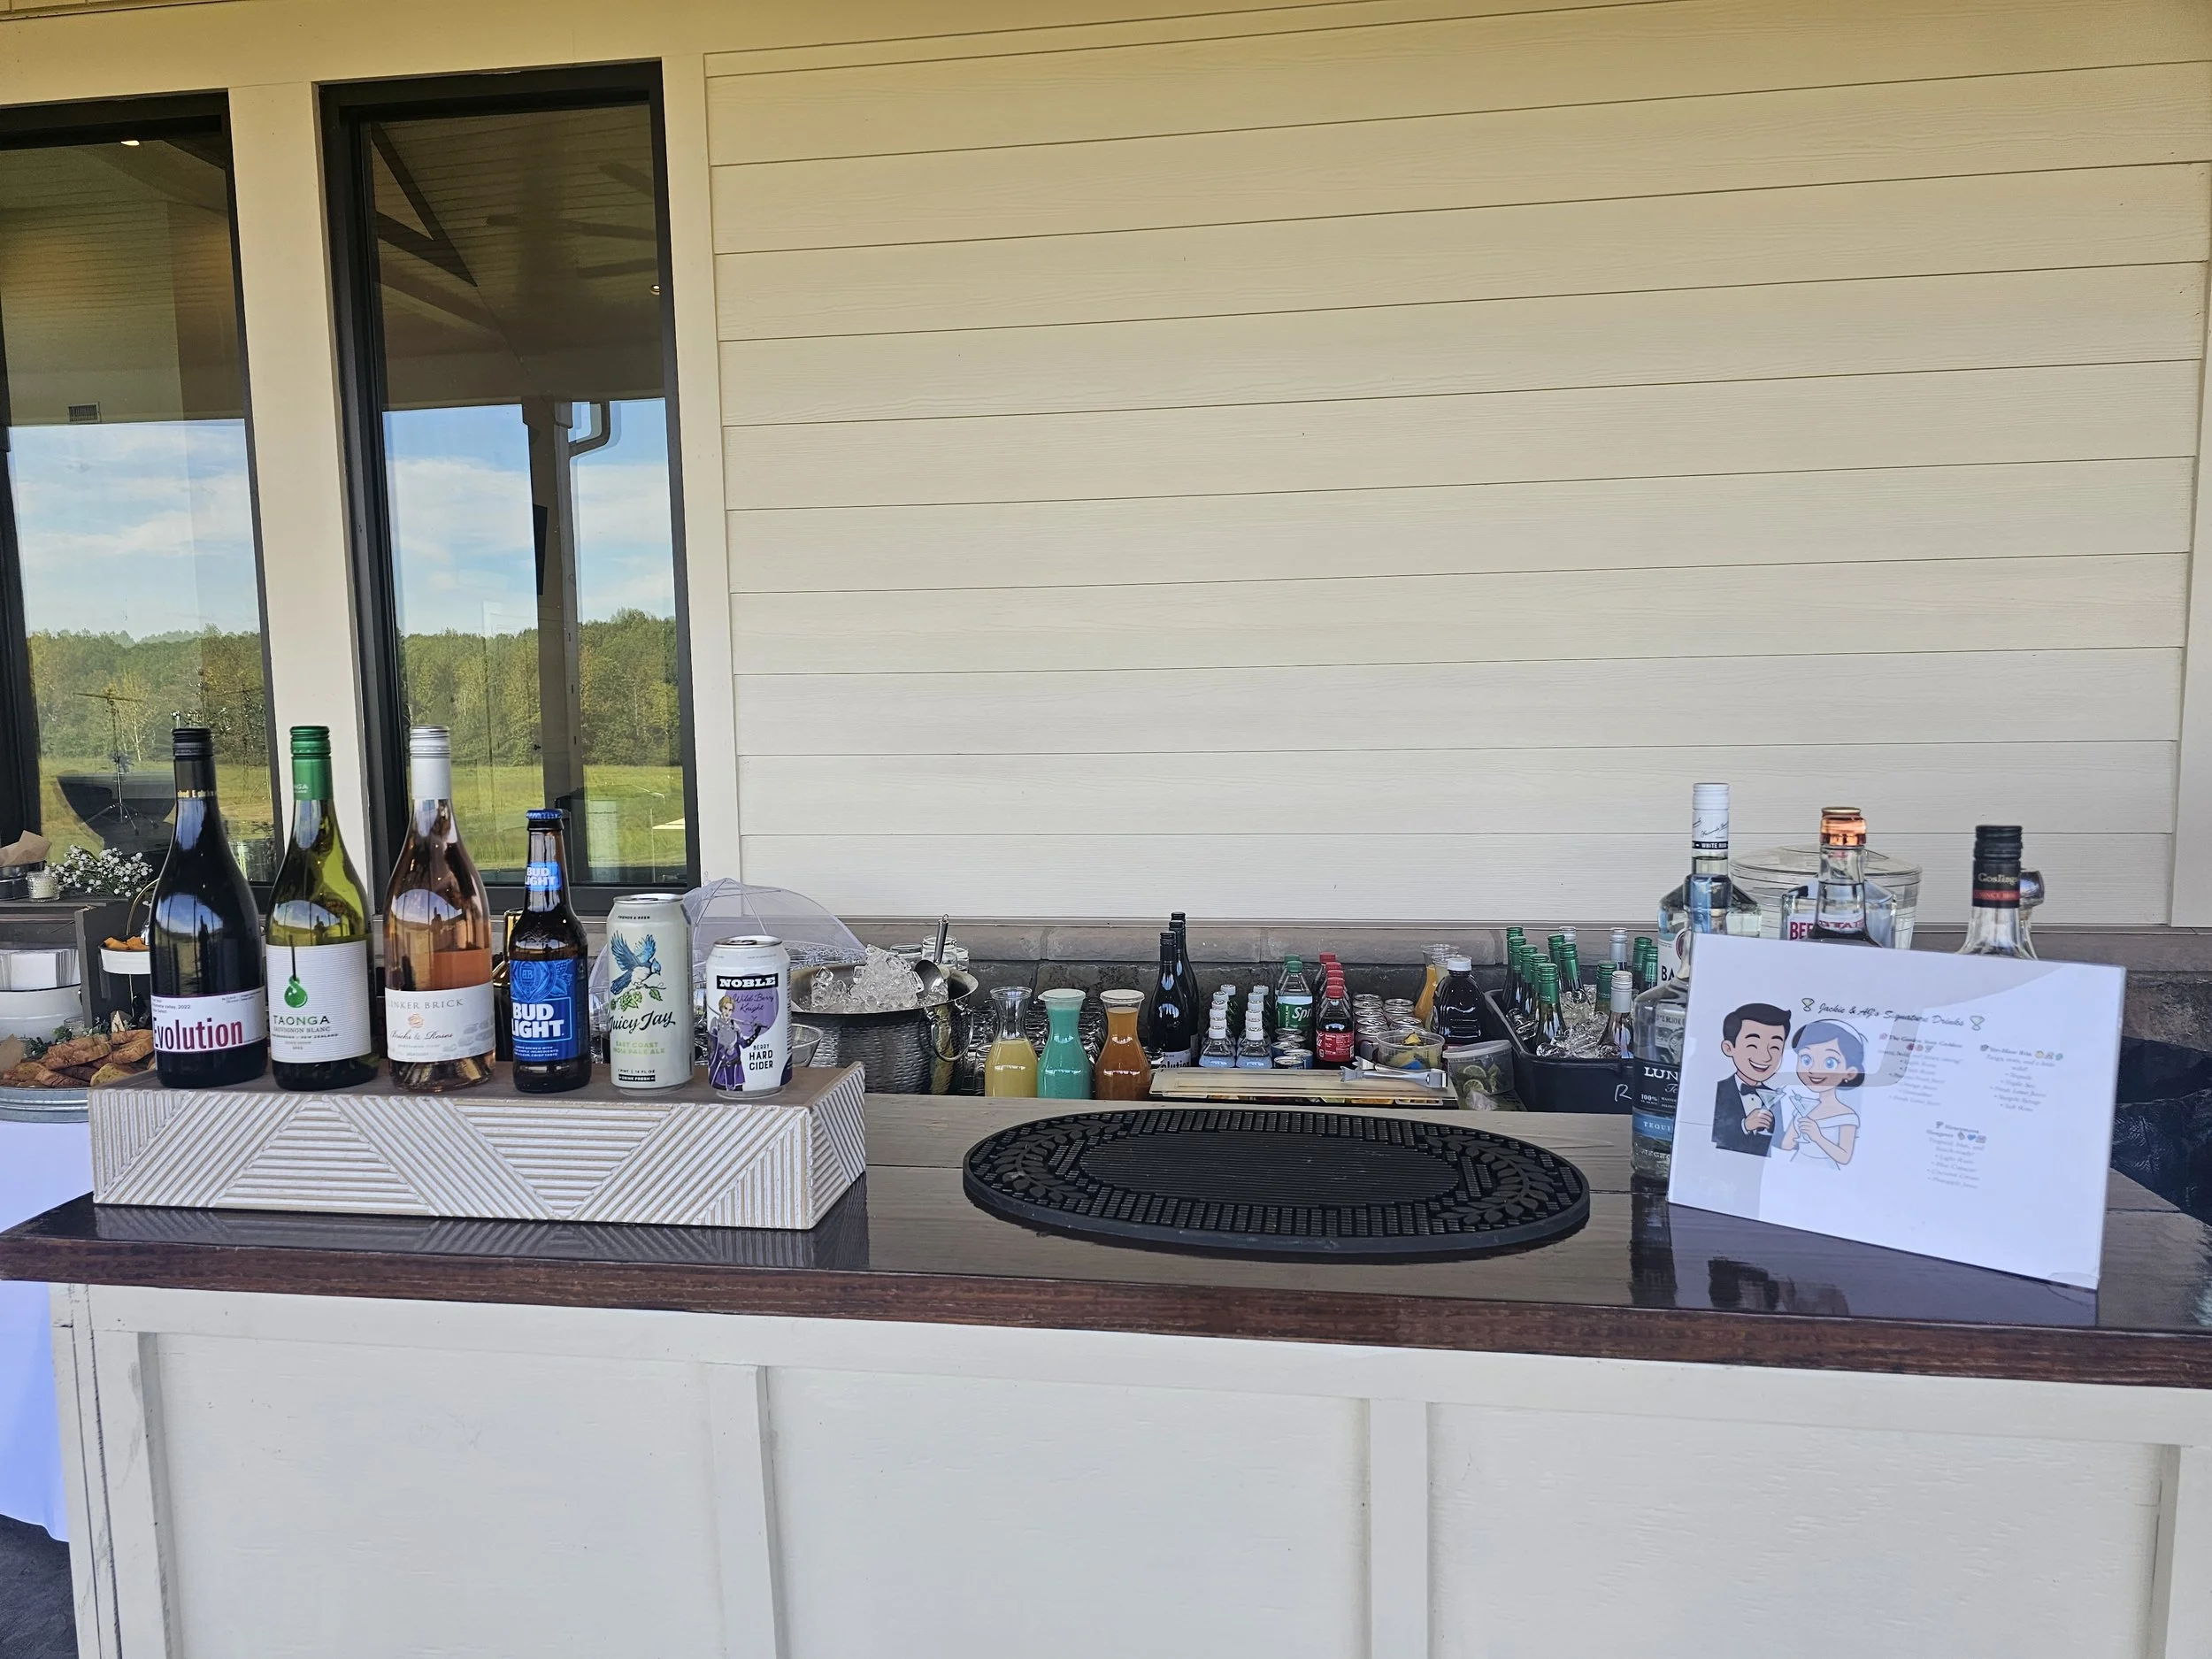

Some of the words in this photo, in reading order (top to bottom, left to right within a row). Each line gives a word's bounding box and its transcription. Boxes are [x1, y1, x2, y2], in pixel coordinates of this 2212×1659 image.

[526, 867, 549, 876] BUD
[719, 977, 776, 988] NOBLE
[426, 998, 465, 1010] BRICK
[753, 993, 774, 1006] Berry
[513, 1002, 555, 1020] BUD
[1817, 1002, 1846, 1015] Jackie
[1848, 1006, 1856, 1015] &
[1932, 1015, 1964, 1026] Drinks
[273, 1015, 331, 1025] TAONGA
[609, 1014, 639, 1033] Juicy
[639, 1010, 676, 1031] Jay
[749, 1051, 773, 1061] HARD
[749, 1061, 773, 1071] CIDER
